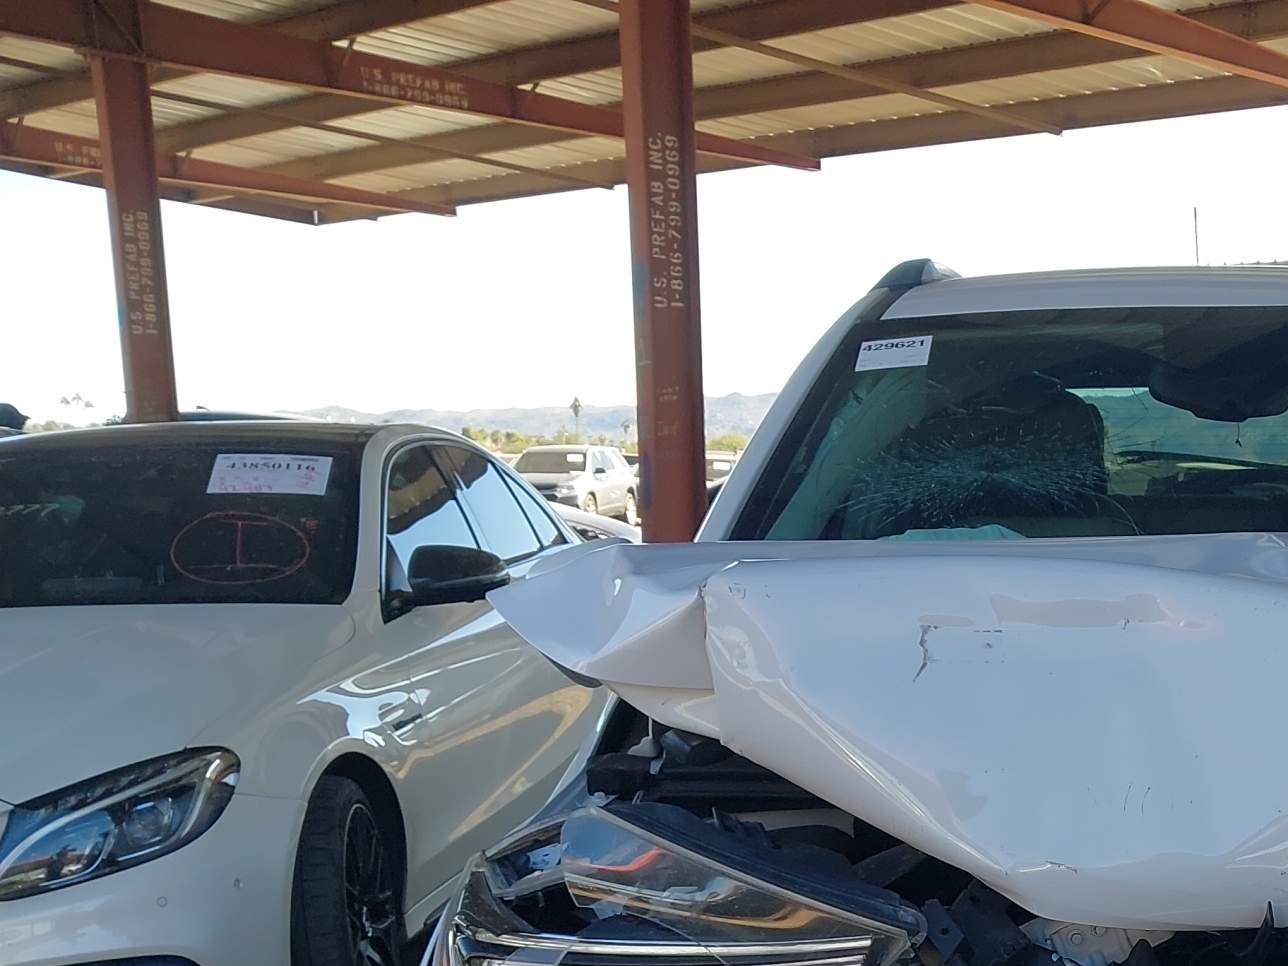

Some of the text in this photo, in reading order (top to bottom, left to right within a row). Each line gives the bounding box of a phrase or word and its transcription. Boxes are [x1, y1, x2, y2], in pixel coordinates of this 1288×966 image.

[647, 132, 668, 308] U.S. PREFAB INC.
[664, 135, 685, 308] 1-866-799-0969
[862, 339, 925, 351] 429621
